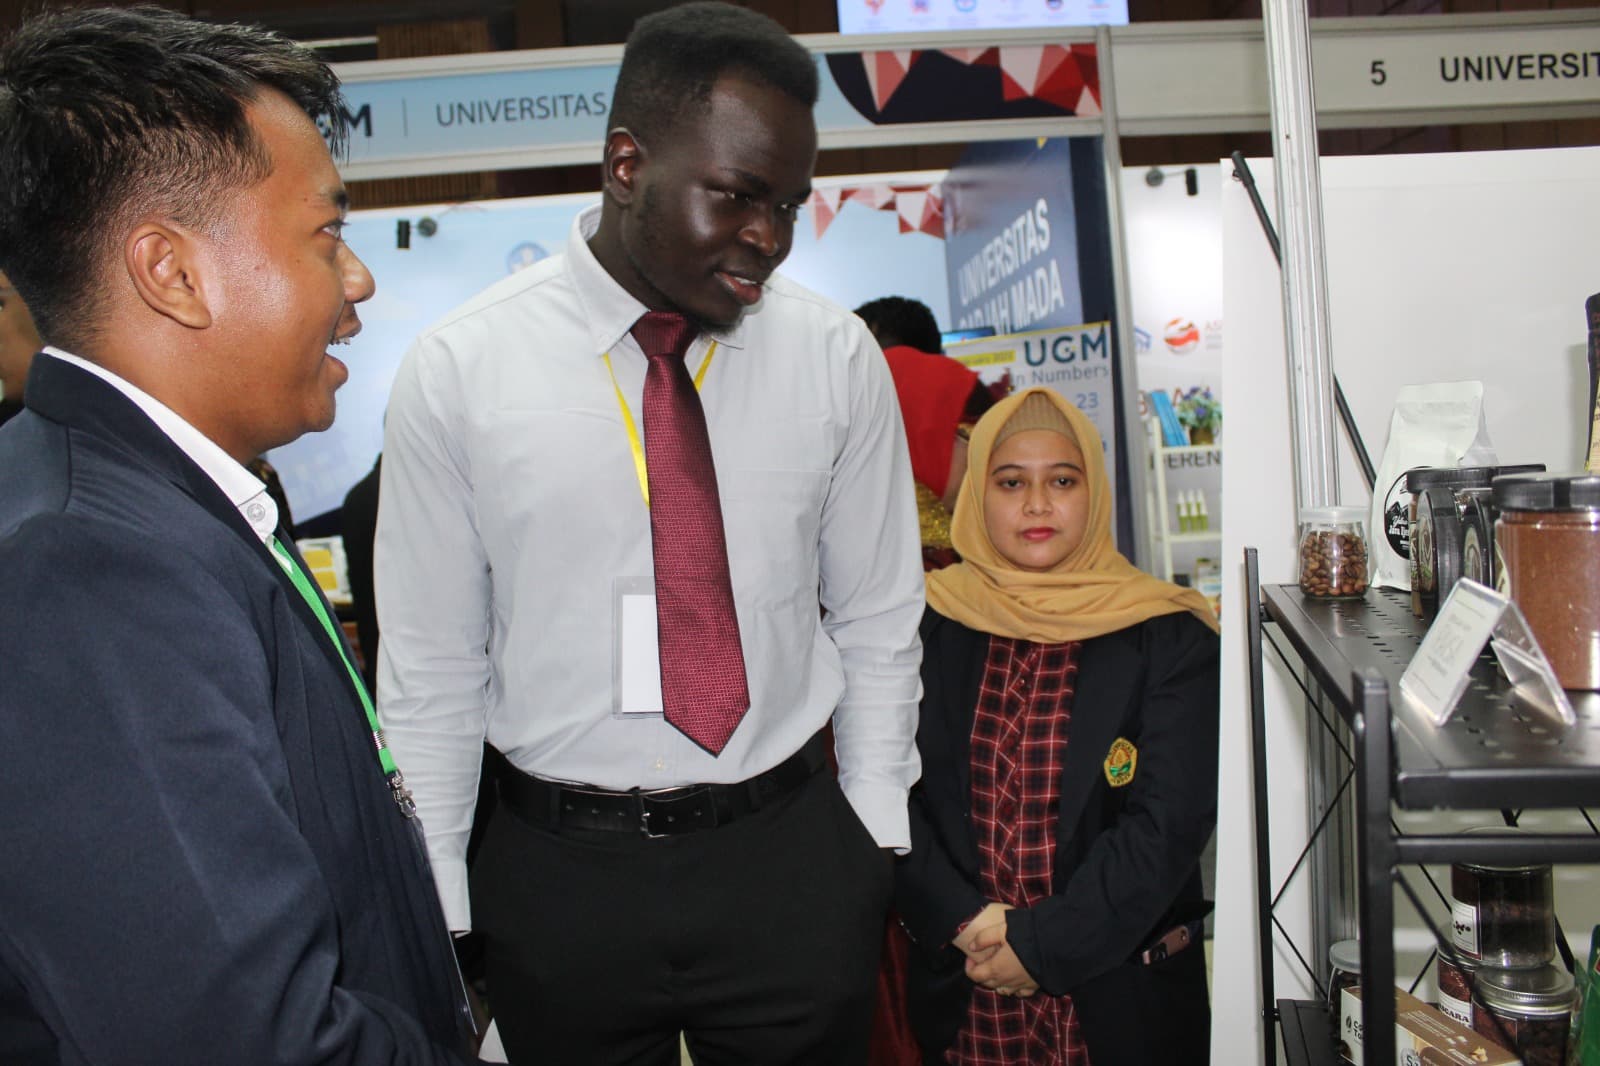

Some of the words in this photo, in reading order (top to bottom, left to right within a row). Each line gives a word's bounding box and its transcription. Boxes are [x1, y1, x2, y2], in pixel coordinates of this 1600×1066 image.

[1370, 60, 1388, 86] 5
[436, 91, 608, 127] UNIVERSITAS
[957, 198, 1050, 307] UNIVERSITAS
[1011, 258, 1065, 332] MADA
[1023, 333, 1108, 367] UGM
[1031, 365, 1110, 387] Numbers
[1076, 393, 1099, 409] 23
